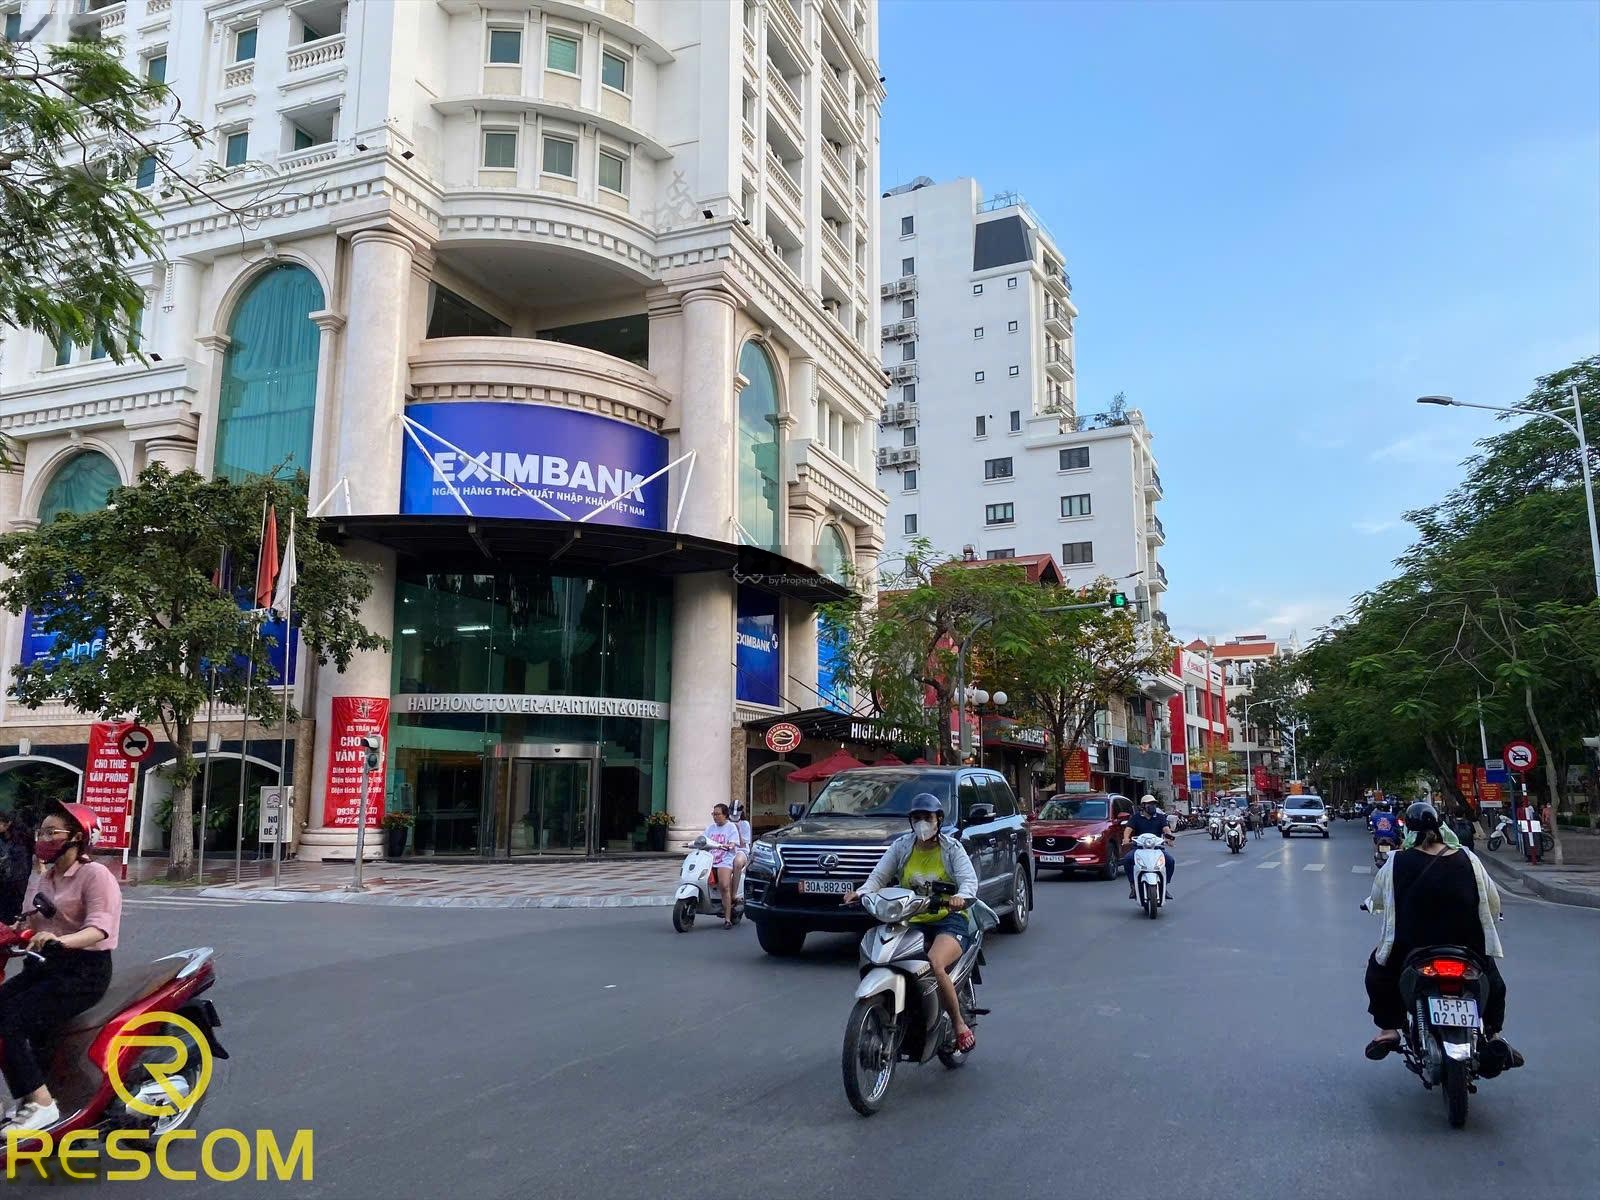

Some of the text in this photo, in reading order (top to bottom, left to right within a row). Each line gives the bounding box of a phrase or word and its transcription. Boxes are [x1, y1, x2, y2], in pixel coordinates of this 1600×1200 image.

[433, 451, 645, 503] EXIMBANK
[462, 485, 493, 496] HÀNG
[556, 491, 584, 504] NHẬP
[629, 505, 645, 517] NAM
[737, 631, 771, 653] EXIMBANK
[341, 736, 361, 747] CHO
[335, 749, 356, 762] VĂN
[1436, 999, 1469, 1013] 15-P1
[1433, 1011, 1475, 1026] 021.87
